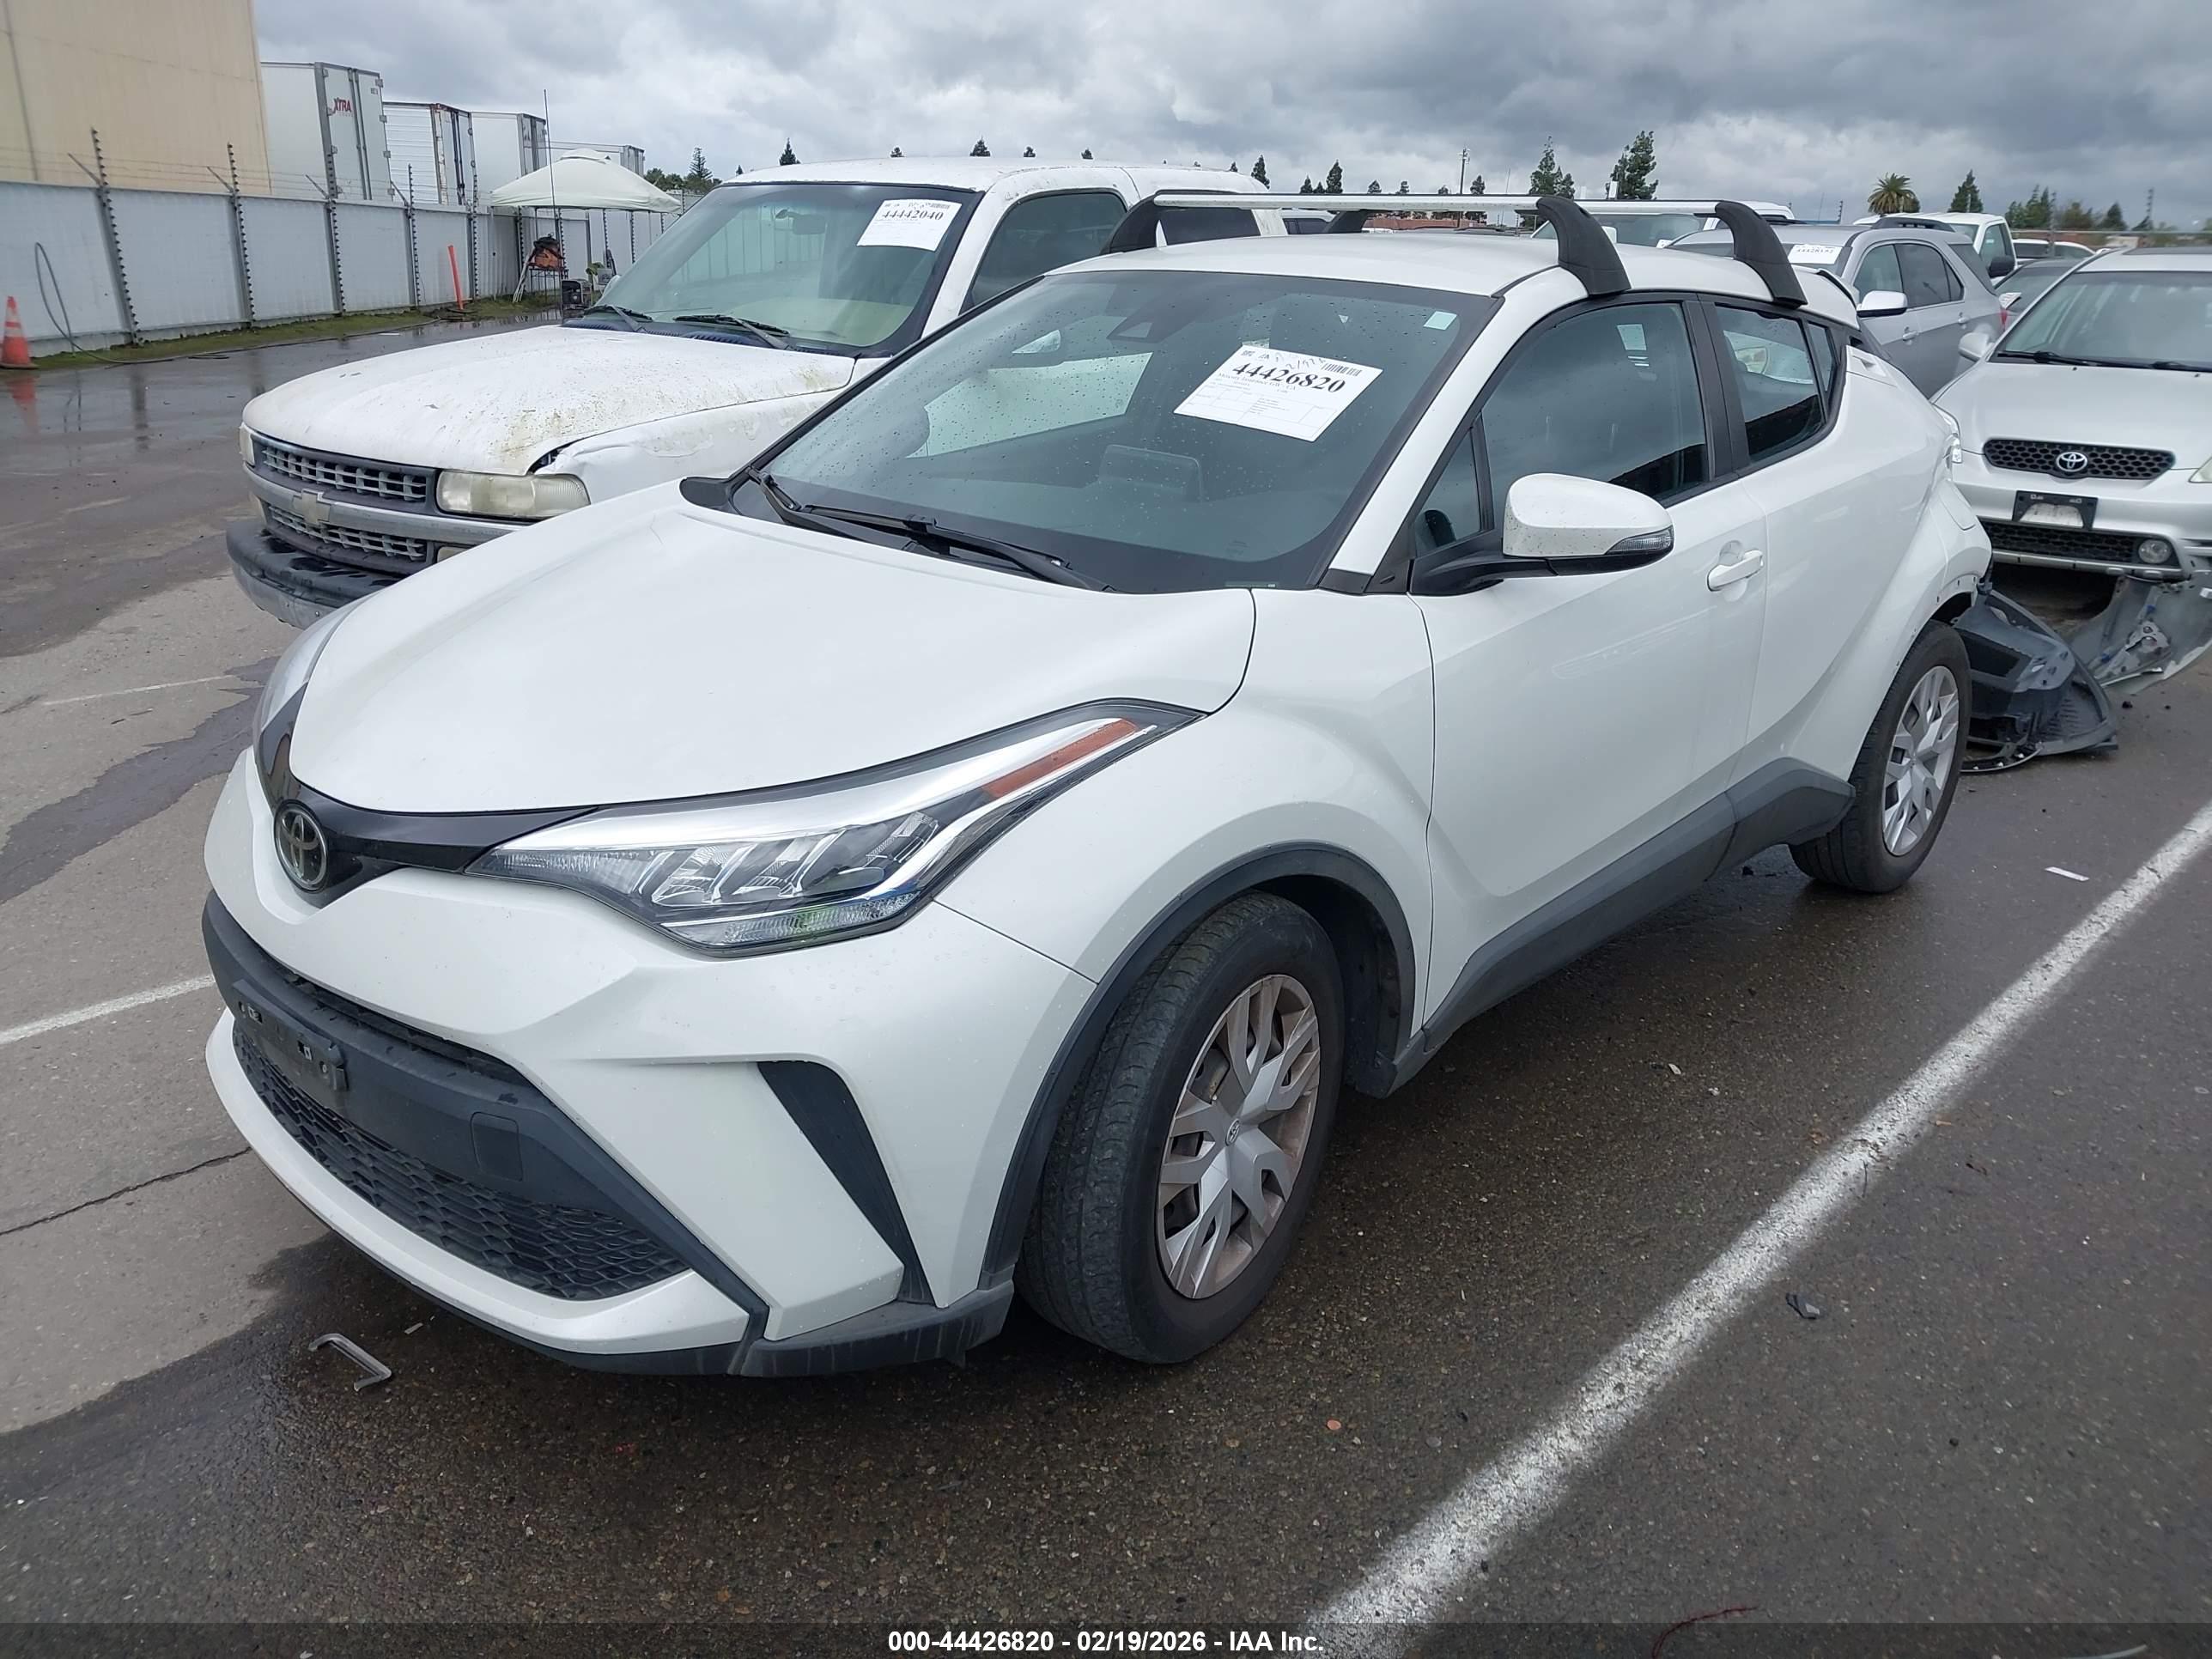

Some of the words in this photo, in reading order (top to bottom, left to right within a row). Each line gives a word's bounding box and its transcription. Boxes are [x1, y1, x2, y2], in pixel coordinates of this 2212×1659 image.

[332, 97, 352, 114] XTRA
[882, 209, 944, 221] 44442040
[1232, 362, 1346, 392] 44426820
